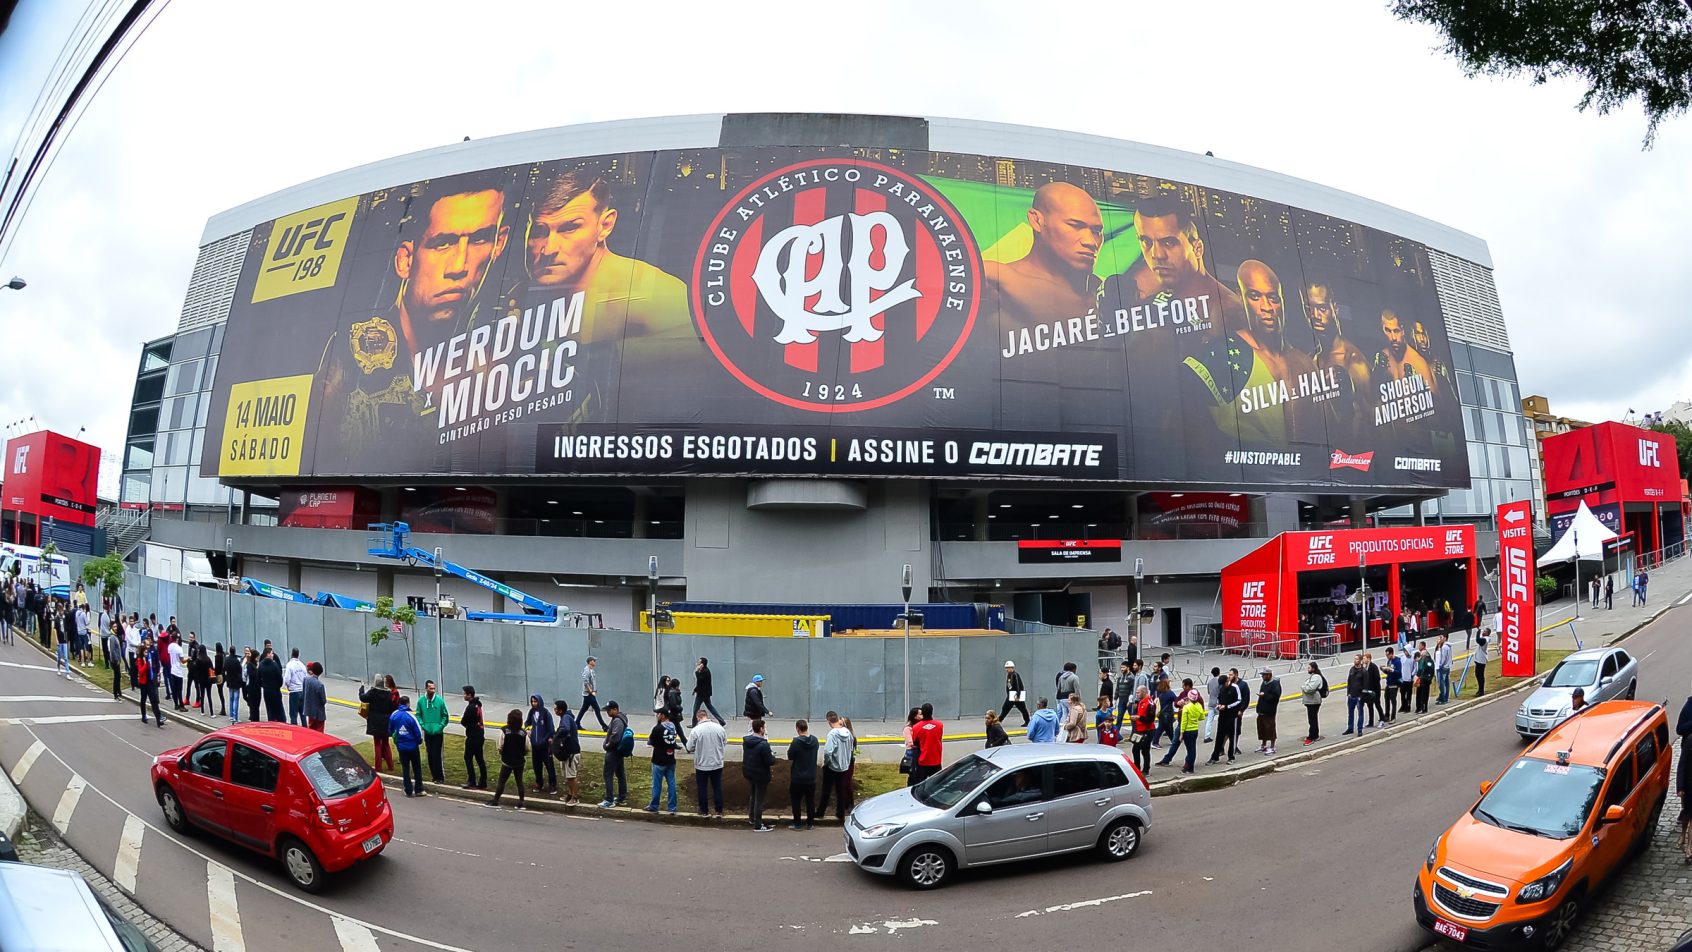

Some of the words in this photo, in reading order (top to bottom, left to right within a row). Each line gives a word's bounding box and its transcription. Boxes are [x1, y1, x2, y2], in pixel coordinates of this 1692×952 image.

[272, 212, 346, 261] UFC
[707, 226, 738, 307] CLUBE
[736, 168, 861, 221] ATLÉTICO
[873, 173, 966, 312] PARANAENSE
[292, 254, 326, 282] 198
[1002, 308, 1099, 358] JACARÉ
[1114, 294, 1210, 335] BELFORT
[1175, 326, 1192, 336] PESO
[1193, 321, 1212, 332] MÉDIO
[413, 290, 585, 392] WERDUM
[438, 340, 577, 429] MIOCIC
[802, 381, 863, 400] 1924
[933, 387, 955, 400] TM
[1239, 379, 1290, 414] SILVA
[1297, 366, 1340, 400] HALL
[1379, 373, 1424, 403] SHOGUN
[236, 399, 252, 429] 14
[252, 393, 297, 428] MAIO
[439, 417, 490, 444] CINTURÃO
[495, 406, 522, 426] PESO
[527, 390, 572, 415] PESADO
[1374, 391, 1434, 427] ANDERSON
[13, 445, 30, 474] UFC
[230, 433, 291, 462] SÁBADO
[553, 435, 673, 458] INGRESSOS
[682, 435, 817, 460] ESGOTADOS
[847, 438, 935, 463] ASSINE
[944, 440, 959, 464] O
[968, 442, 1103, 466] COMBATE
[1224, 450, 1302, 466] #UNSTOPPABLE
[1330, 452, 1372, 466] Budweiser
[1638, 438, 1660, 468] UFC
[1394, 456, 1441, 472] COMBATE
[1308, 535, 1334, 550] UFC
[1349, 540, 1399, 554] PRODUTOS
[1400, 537, 1434, 551] OFICIAIS
[1444, 529, 1463, 542] UFC
[1502, 527, 1526, 539] VISITE
[1307, 553, 1336, 565] STORE
[1444, 544, 1464, 555] STORE
[1509, 548, 1527, 602] UFC
[1242, 581, 1265, 598] UFC
[1240, 604, 1267, 617] STORE
[1240, 619, 1266, 628] PRODUTOS
[1506, 601, 1521, 665] STORE
